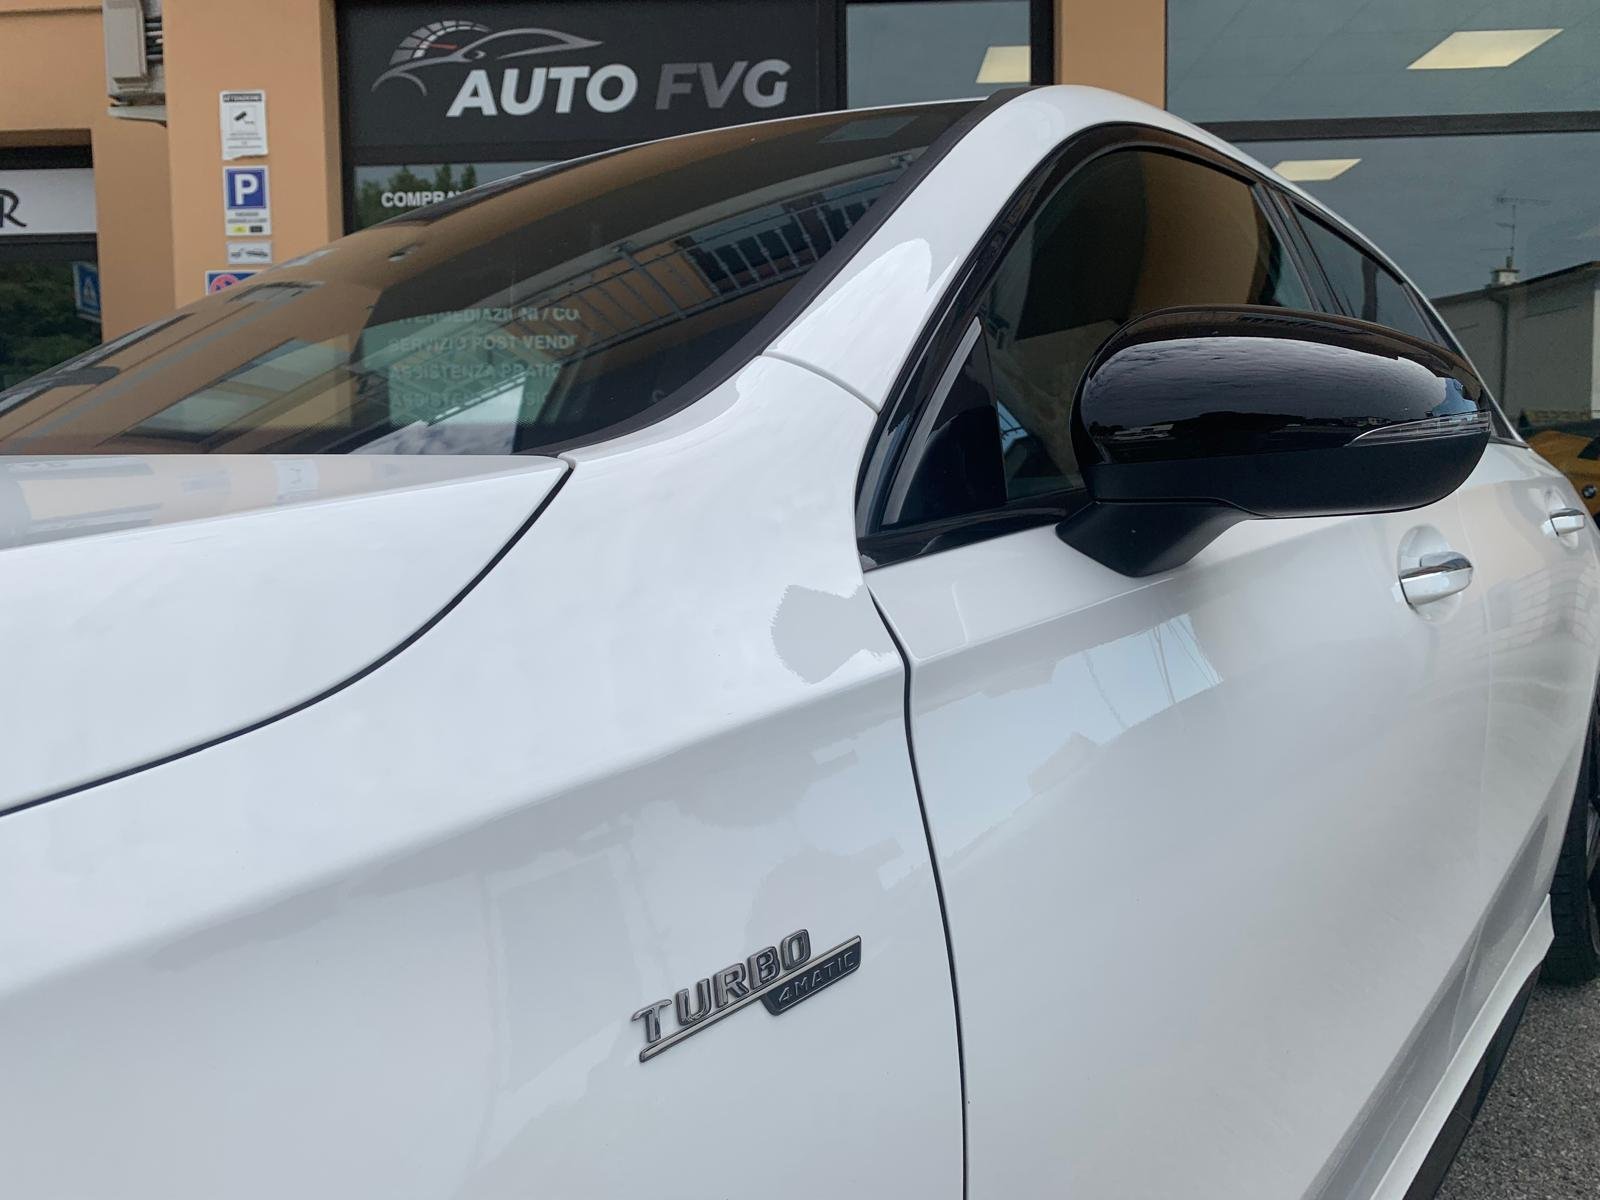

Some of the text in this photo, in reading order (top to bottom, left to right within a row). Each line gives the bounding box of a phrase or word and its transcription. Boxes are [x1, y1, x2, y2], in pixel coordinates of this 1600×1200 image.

[446, 59, 792, 117] AUTO FVG
[235, 173, 258, 206] P
[631, 928, 811, 1043] TURBO
[778, 951, 855, 1004] 4MATIC
